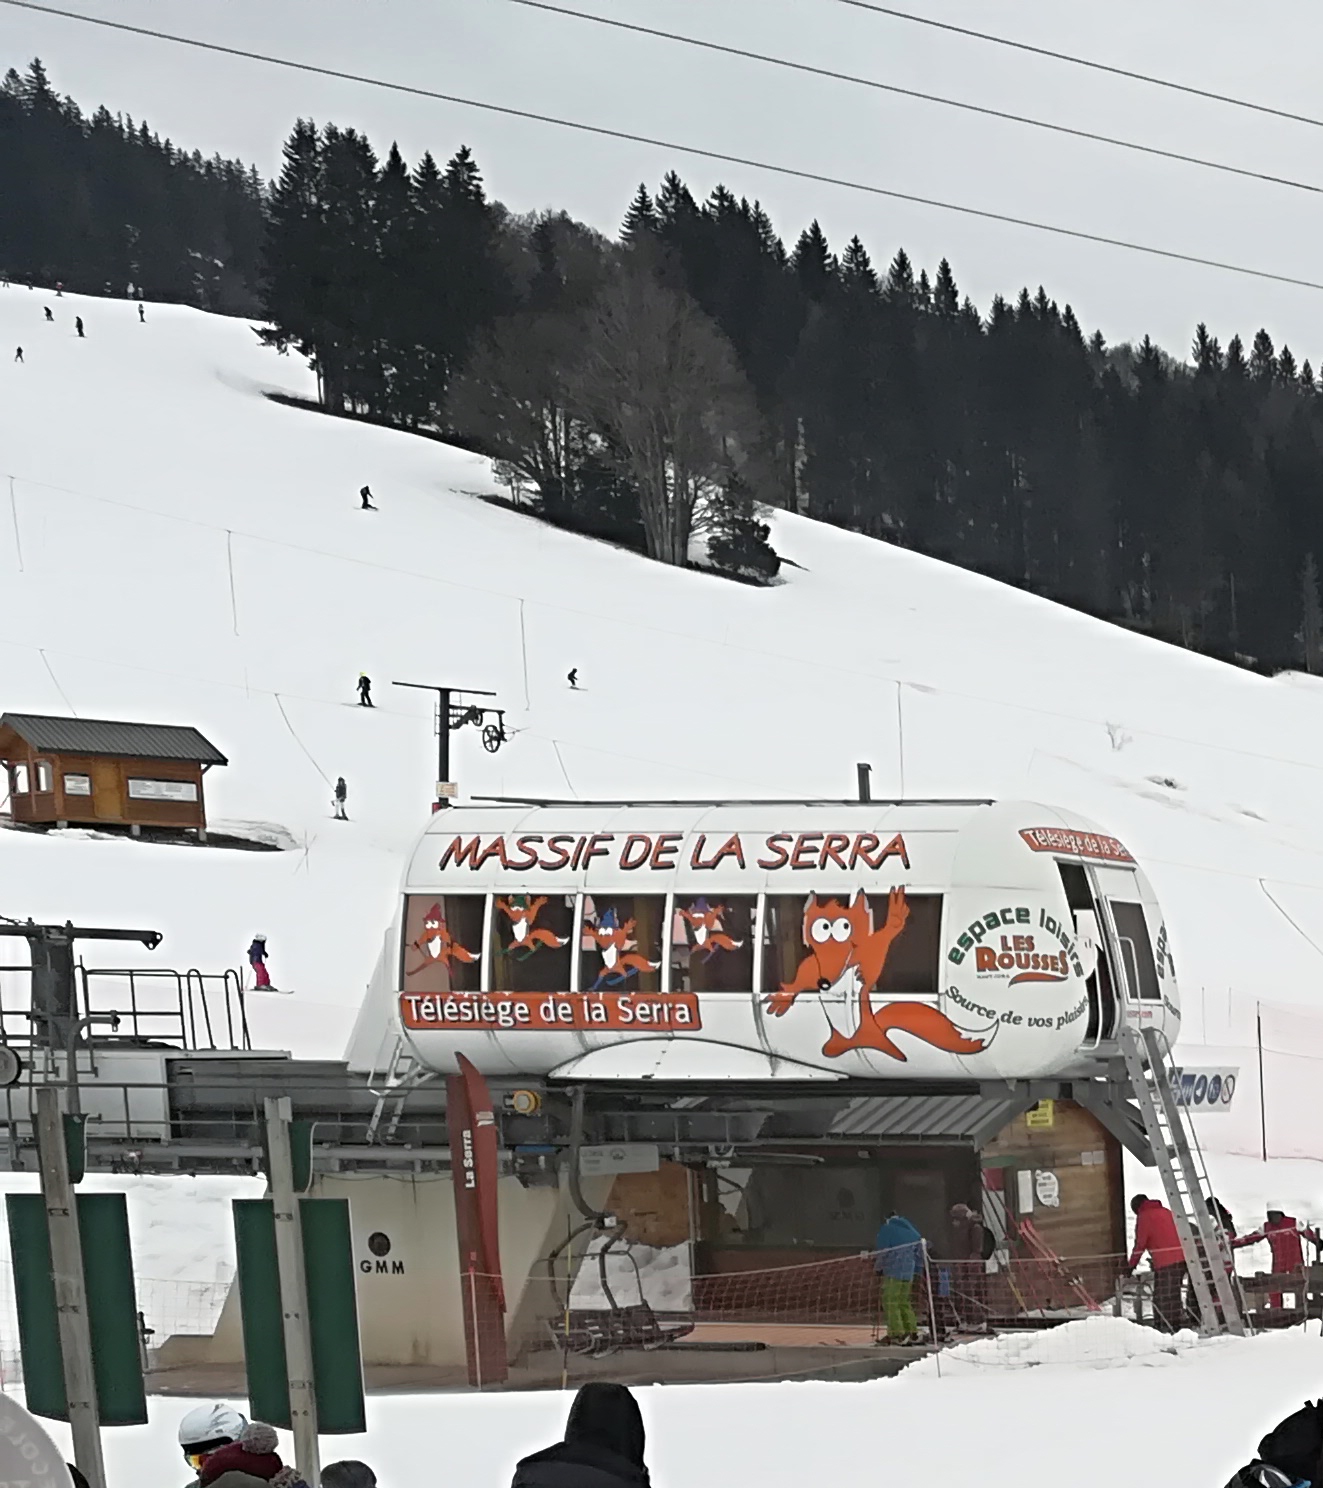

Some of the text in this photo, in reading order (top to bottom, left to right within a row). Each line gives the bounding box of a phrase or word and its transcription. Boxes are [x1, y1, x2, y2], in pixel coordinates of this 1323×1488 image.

[439, 832, 911, 871] MASSIF DE LA SERRA
[948, 907, 1085, 978] espace loisirs
[1000, 935, 1035, 952] LES
[975, 946, 1069, 975] ROUSSES
[405, 996, 691, 1027] Télésiège de la Serra
[945, 986, 997, 1019] Source
[1000, 1010, 1023, 1026] de
[1028, 1016, 1053, 1028] vos
[462, 1129, 476, 1188] La Serra
[360, 1259, 405, 1275] GMM
